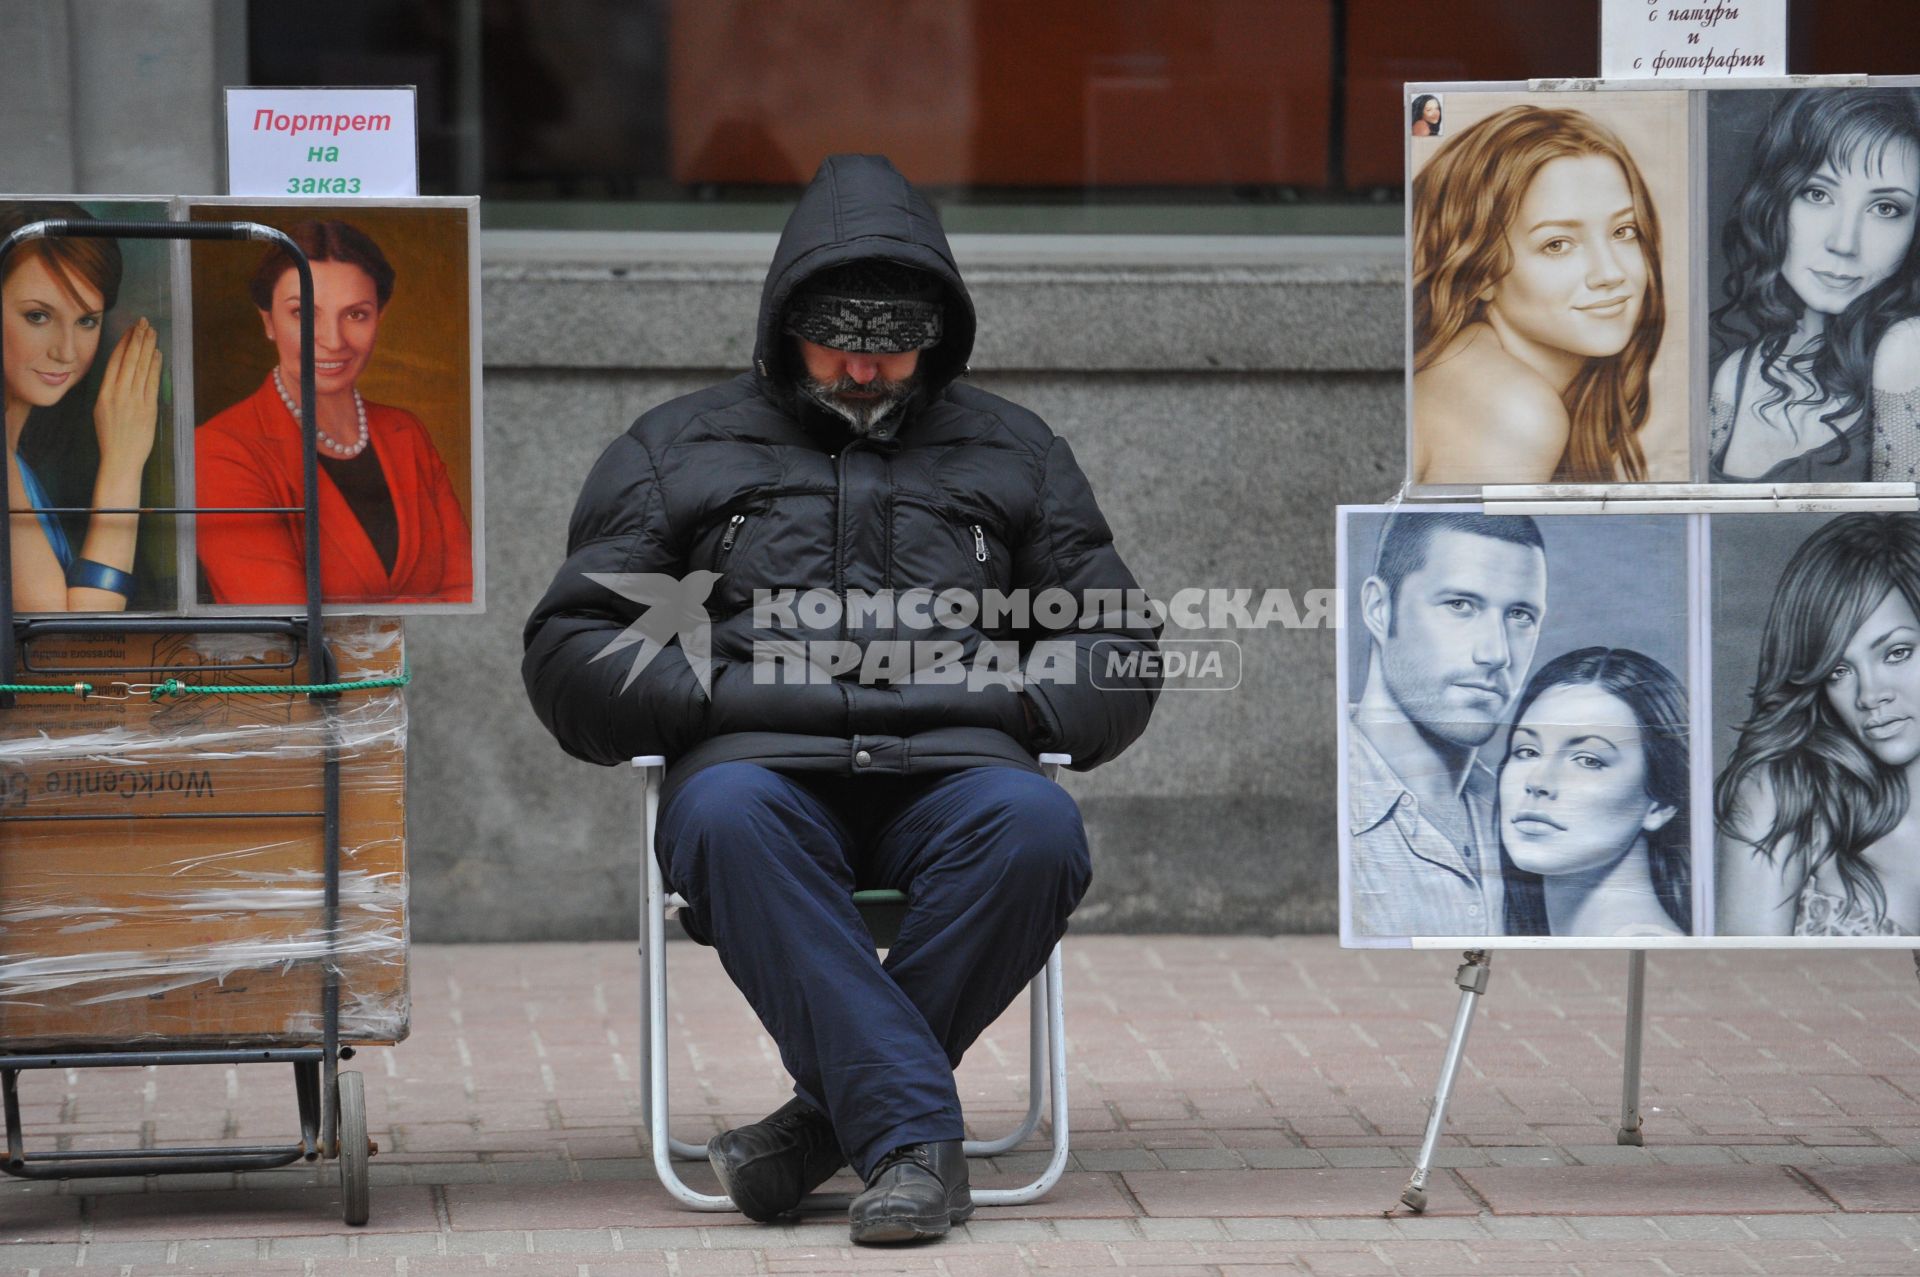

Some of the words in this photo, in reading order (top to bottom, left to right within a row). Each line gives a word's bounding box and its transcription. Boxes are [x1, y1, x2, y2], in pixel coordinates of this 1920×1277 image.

[1648, 9, 1658, 21] с
[1668, 1, 1739, 27] натуры
[1687, 32, 1700, 44] и
[1633, 56, 1643, 69] с
[1652, 47, 1766, 76] фотографии
[253, 109, 391, 136] Портрет
[307, 146, 339, 162] на
[286, 177, 361, 194] заказ
